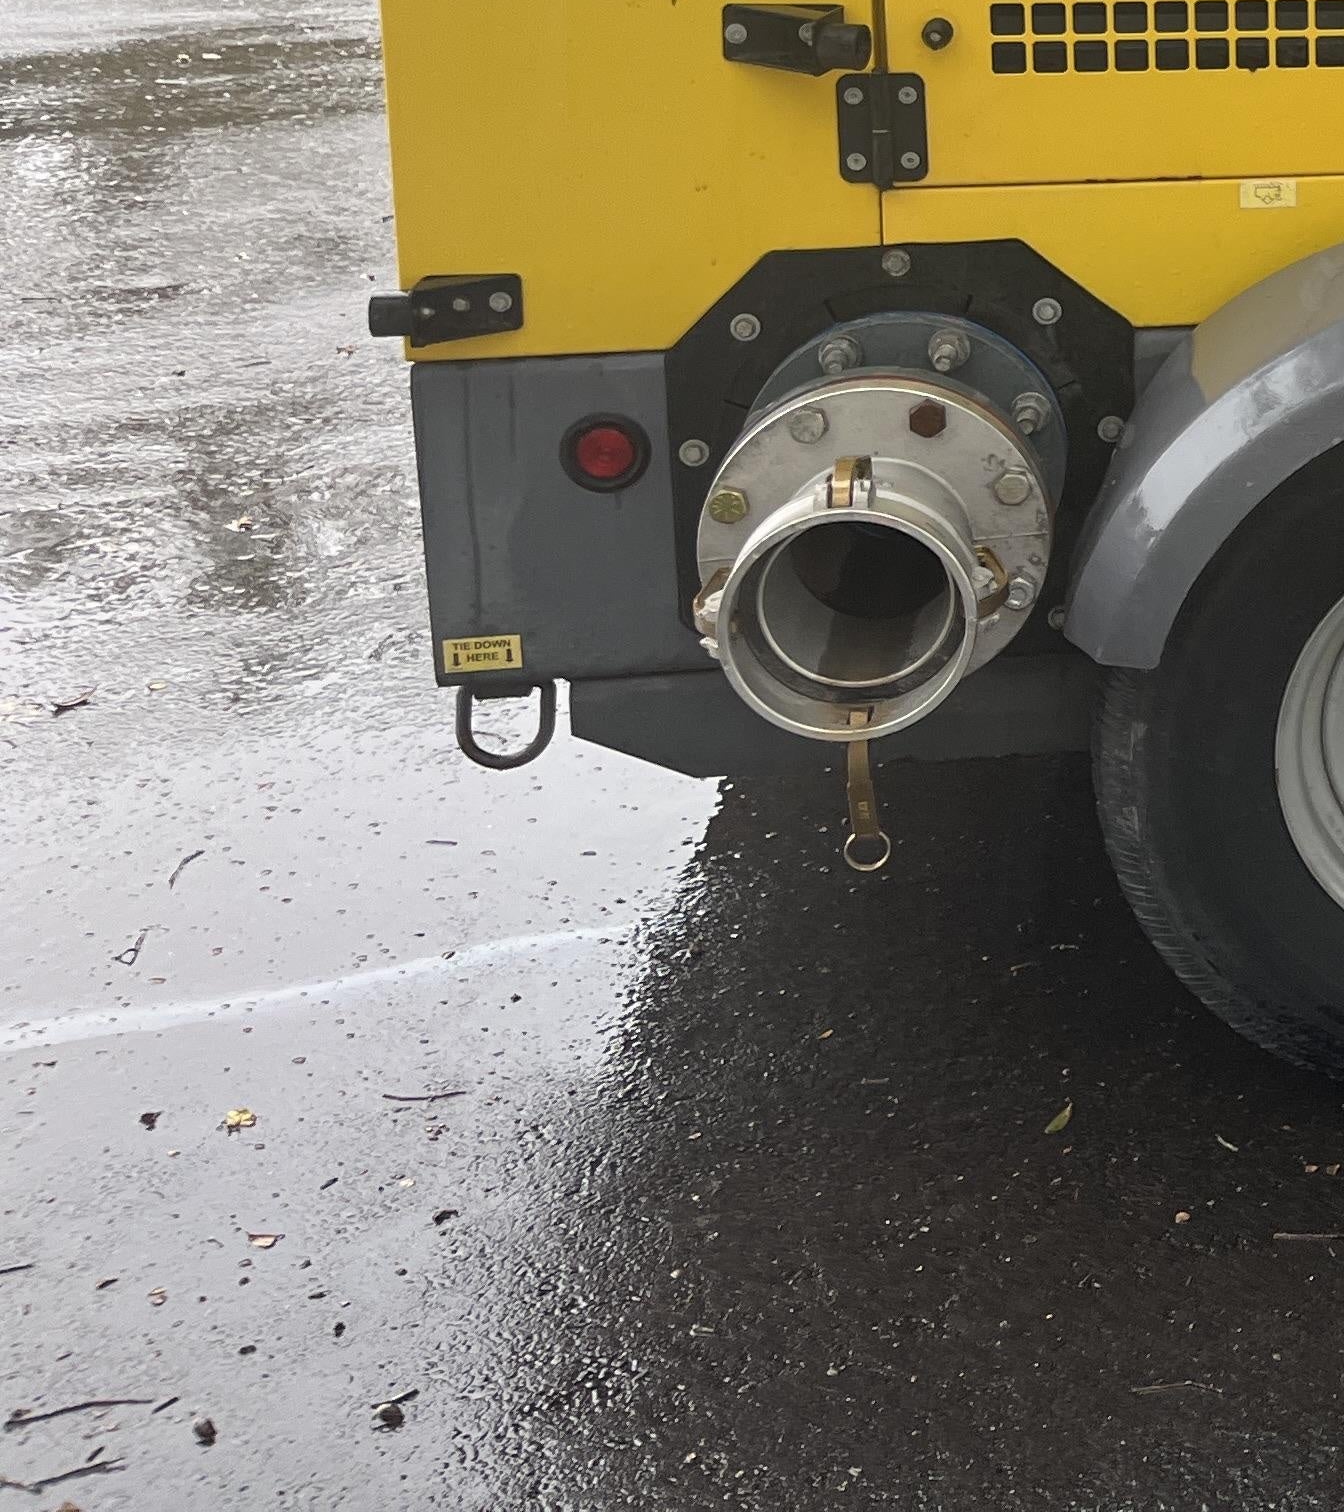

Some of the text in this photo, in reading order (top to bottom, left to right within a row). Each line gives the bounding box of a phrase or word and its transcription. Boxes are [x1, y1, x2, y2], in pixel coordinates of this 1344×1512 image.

[452, 639, 511, 651] TIE DOWN
[466, 651, 499, 662] HERE
